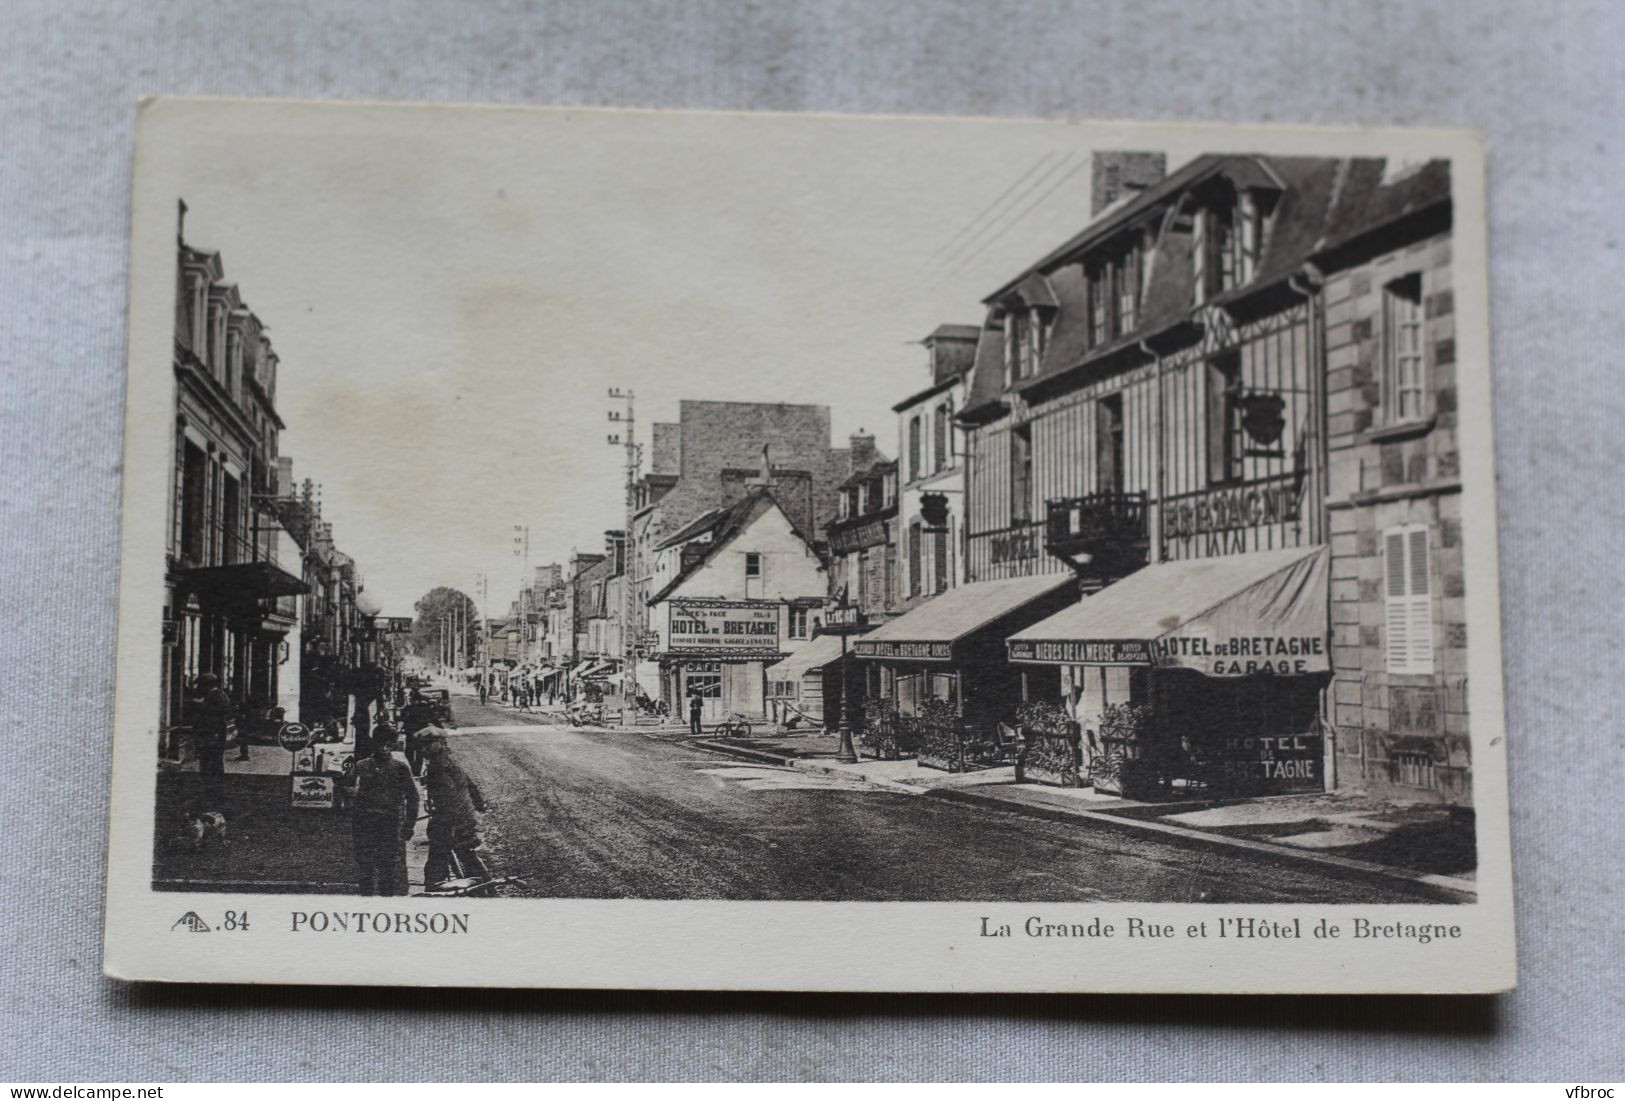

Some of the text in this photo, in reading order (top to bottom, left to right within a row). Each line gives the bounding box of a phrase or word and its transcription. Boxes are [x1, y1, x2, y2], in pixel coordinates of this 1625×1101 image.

[671, 620, 710, 634] HOTEL
[723, 621, 777, 635] BRETAGNE
[1157, 637, 1212, 657] HOTEL
[1214, 644, 1228, 656] DE
[1229, 637, 1323, 656] BRETAGNE
[687, 662, 720, 671] CAFE
[1214, 660, 1308, 674] GARAGE
[290, 911, 471, 934] PONTORSON
[980, 916, 1462, 944] La Grande Rue et l'Hôtel de Bretagne
